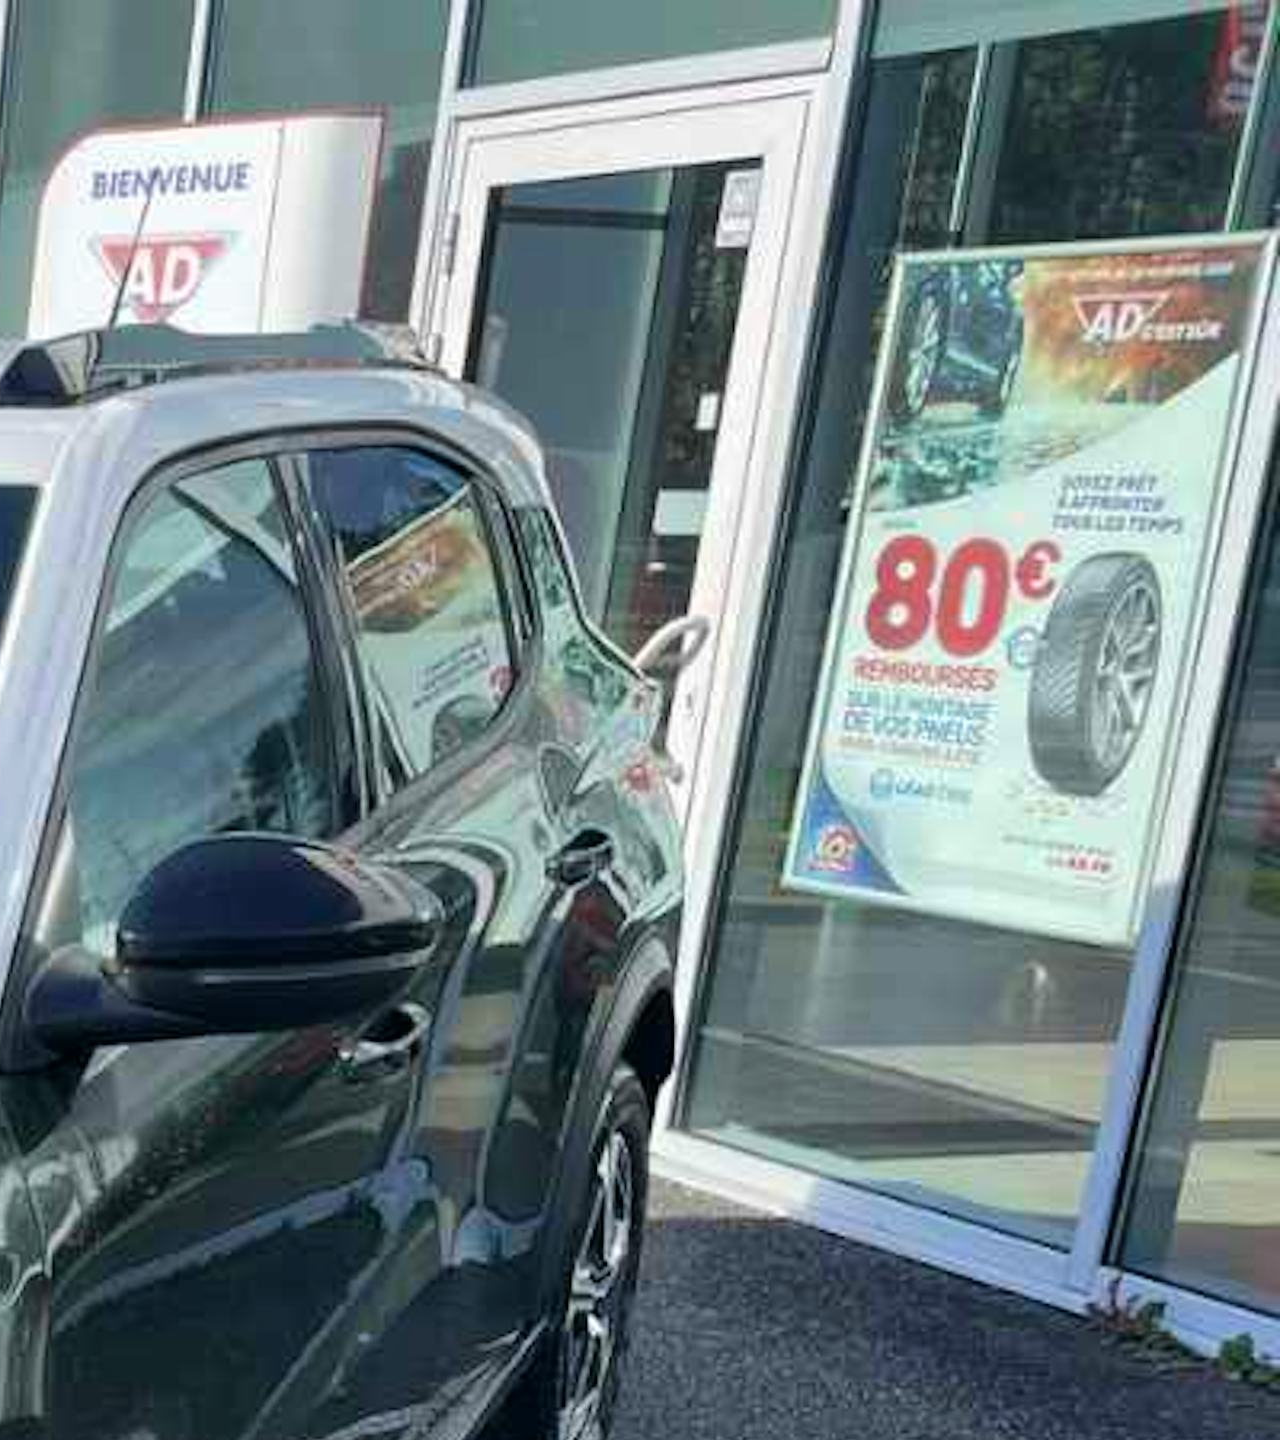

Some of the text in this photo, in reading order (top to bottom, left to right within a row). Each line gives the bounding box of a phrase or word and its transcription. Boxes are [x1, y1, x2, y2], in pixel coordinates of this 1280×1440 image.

[91, 162, 251, 199] BIENVENUE
[125, 246, 204, 304] AD
[1083, 303, 1142, 343] AD
